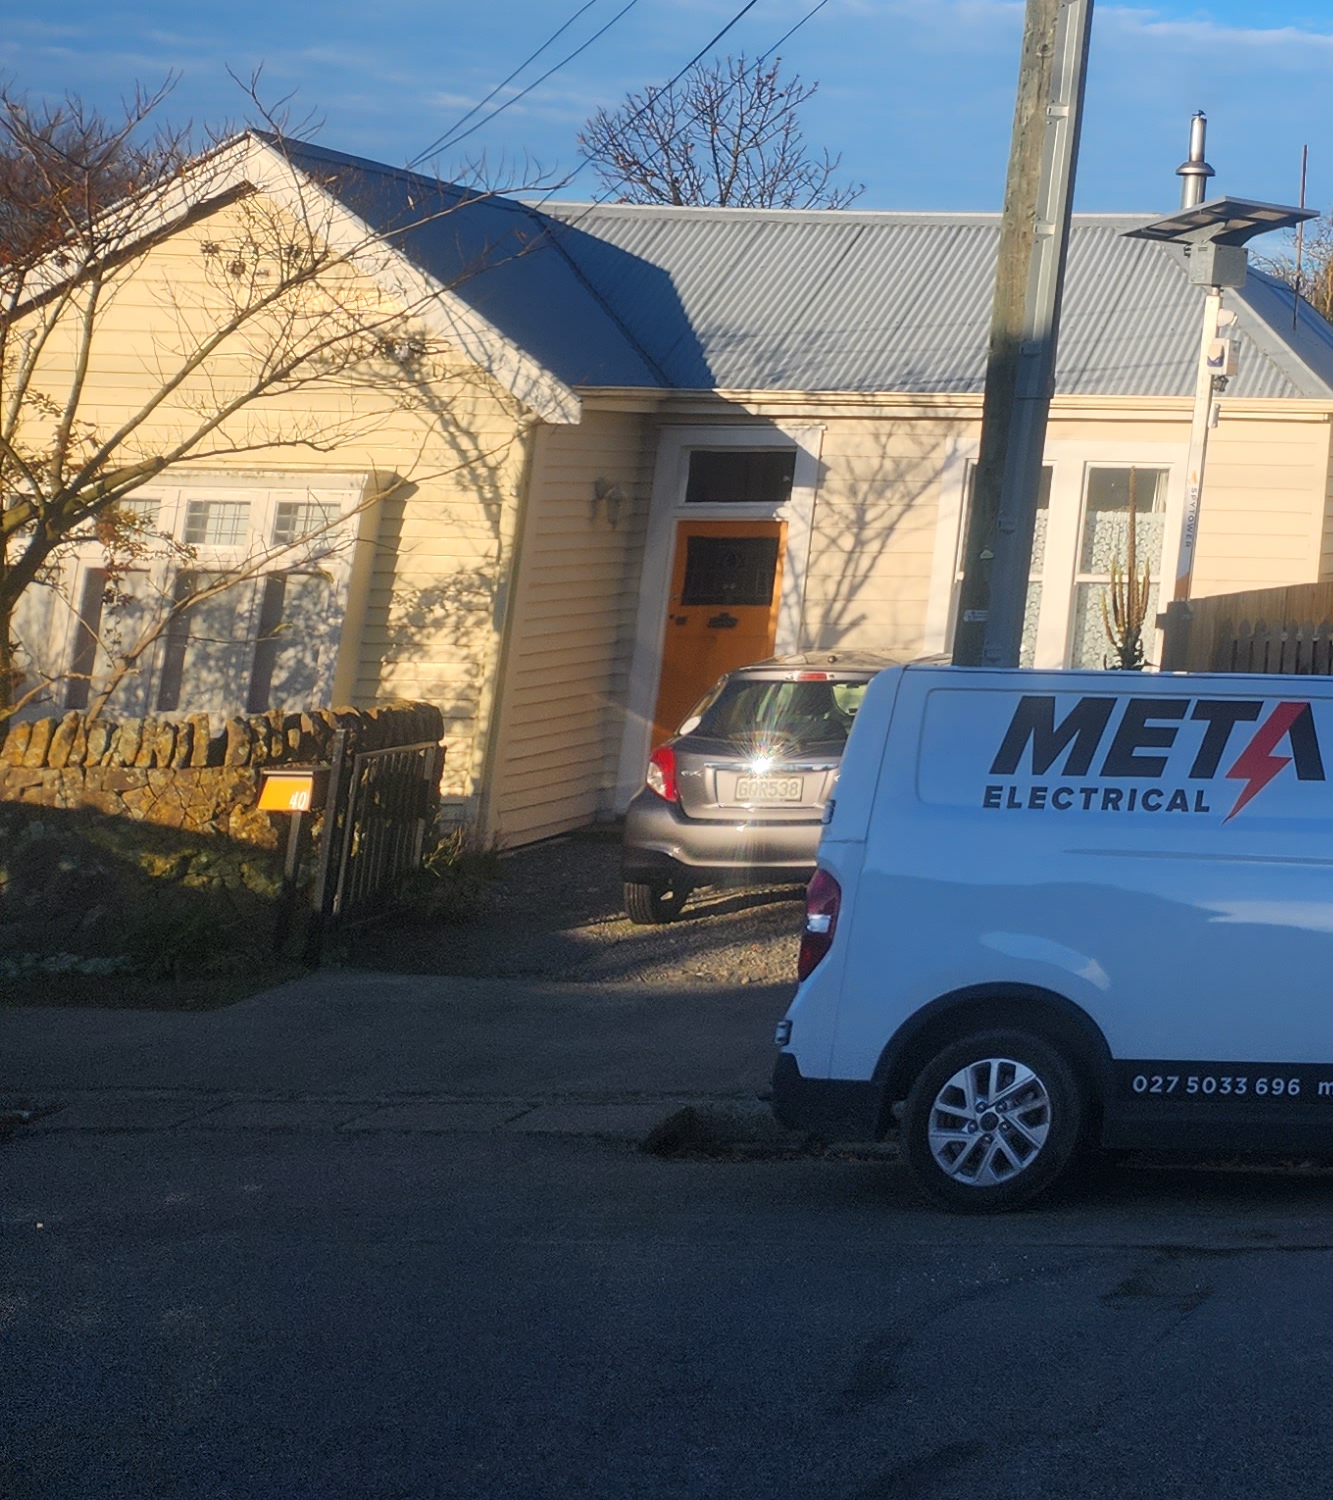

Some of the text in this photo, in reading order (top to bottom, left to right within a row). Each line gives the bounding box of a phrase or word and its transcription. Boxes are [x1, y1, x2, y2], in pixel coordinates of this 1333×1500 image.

[1185, 487, 1197, 548] SPYTOWER
[989, 695, 1326, 825] META
[289, 791, 306, 810] 40
[982, 785, 1210, 812] ELECTRICAL
[1132, 1075, 1178, 1094] 027
[1185, 1075, 1247, 1095] 5033
[1255, 1075, 1301, 1096] 696
